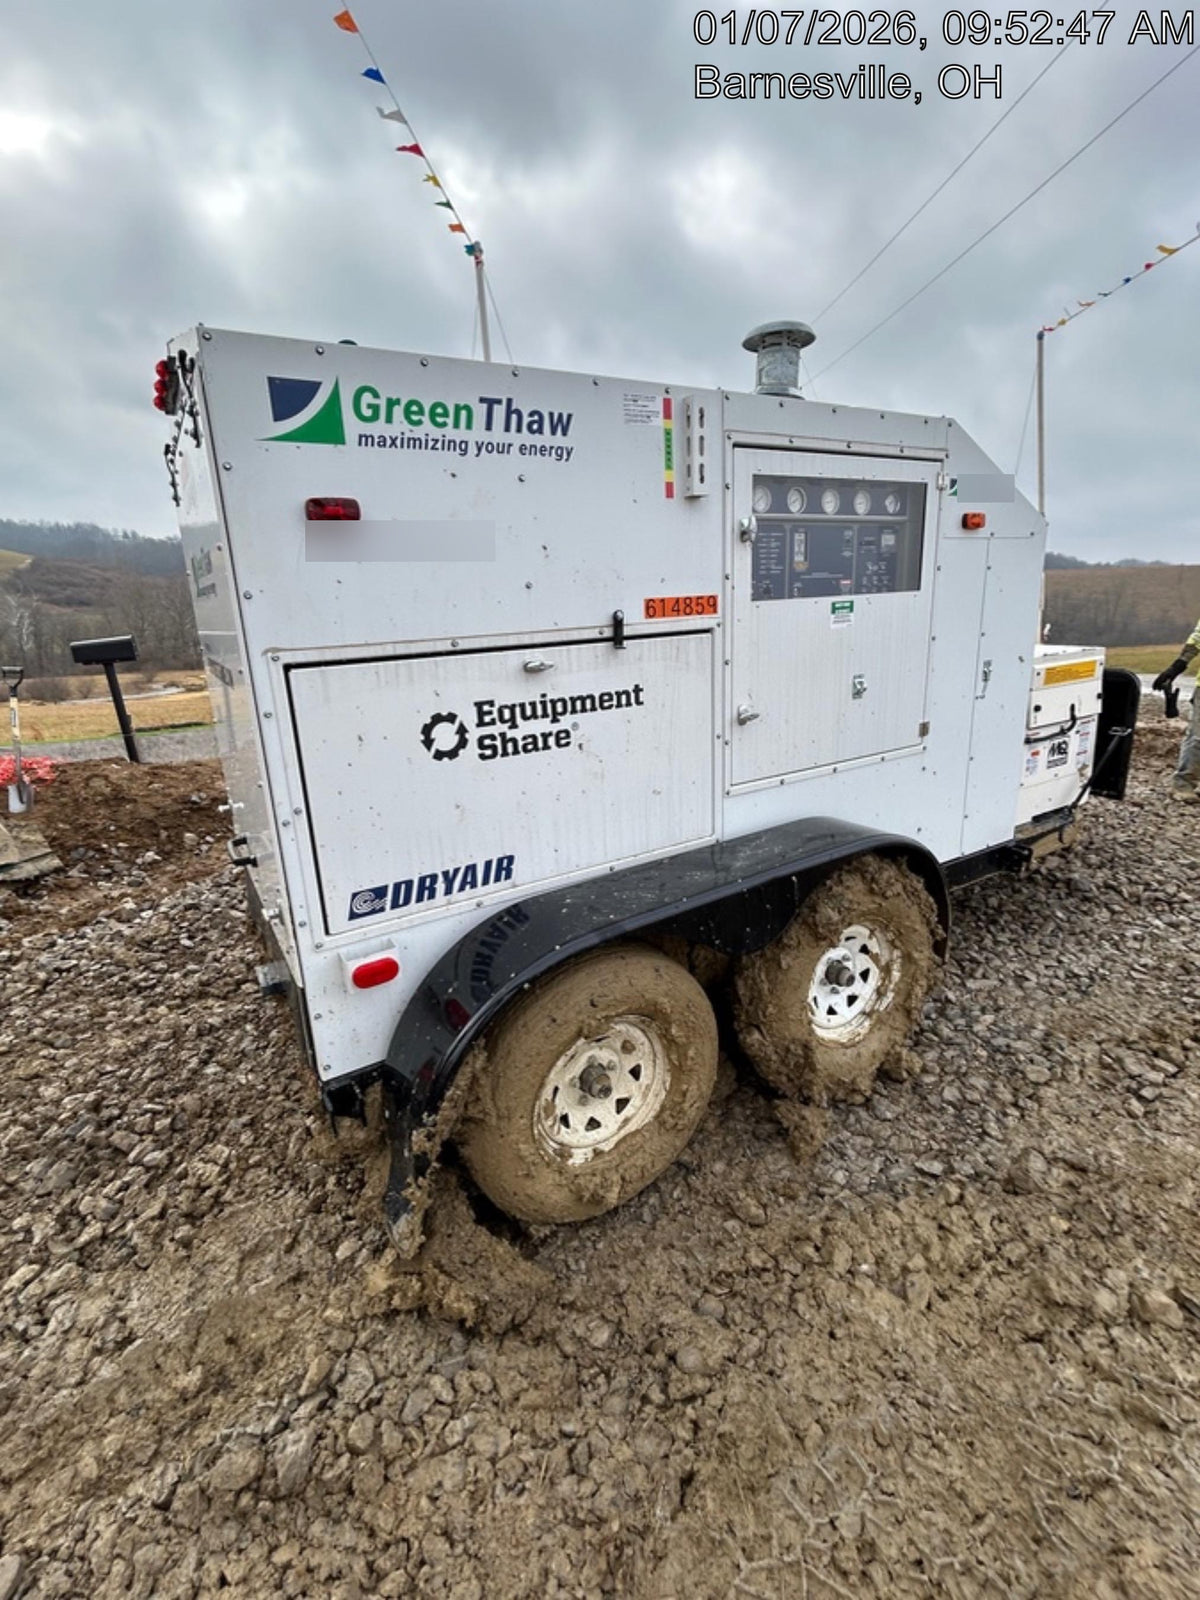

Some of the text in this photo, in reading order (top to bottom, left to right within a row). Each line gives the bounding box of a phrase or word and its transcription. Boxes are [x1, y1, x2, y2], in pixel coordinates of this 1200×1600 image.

[358, 431, 574, 462] maximizing your energy
[645, 595, 718, 618] 614859
[474, 684, 644, 729] Equipment
[477, 728, 572, 761] Share
[390, 854, 515, 911] DRYAIR
